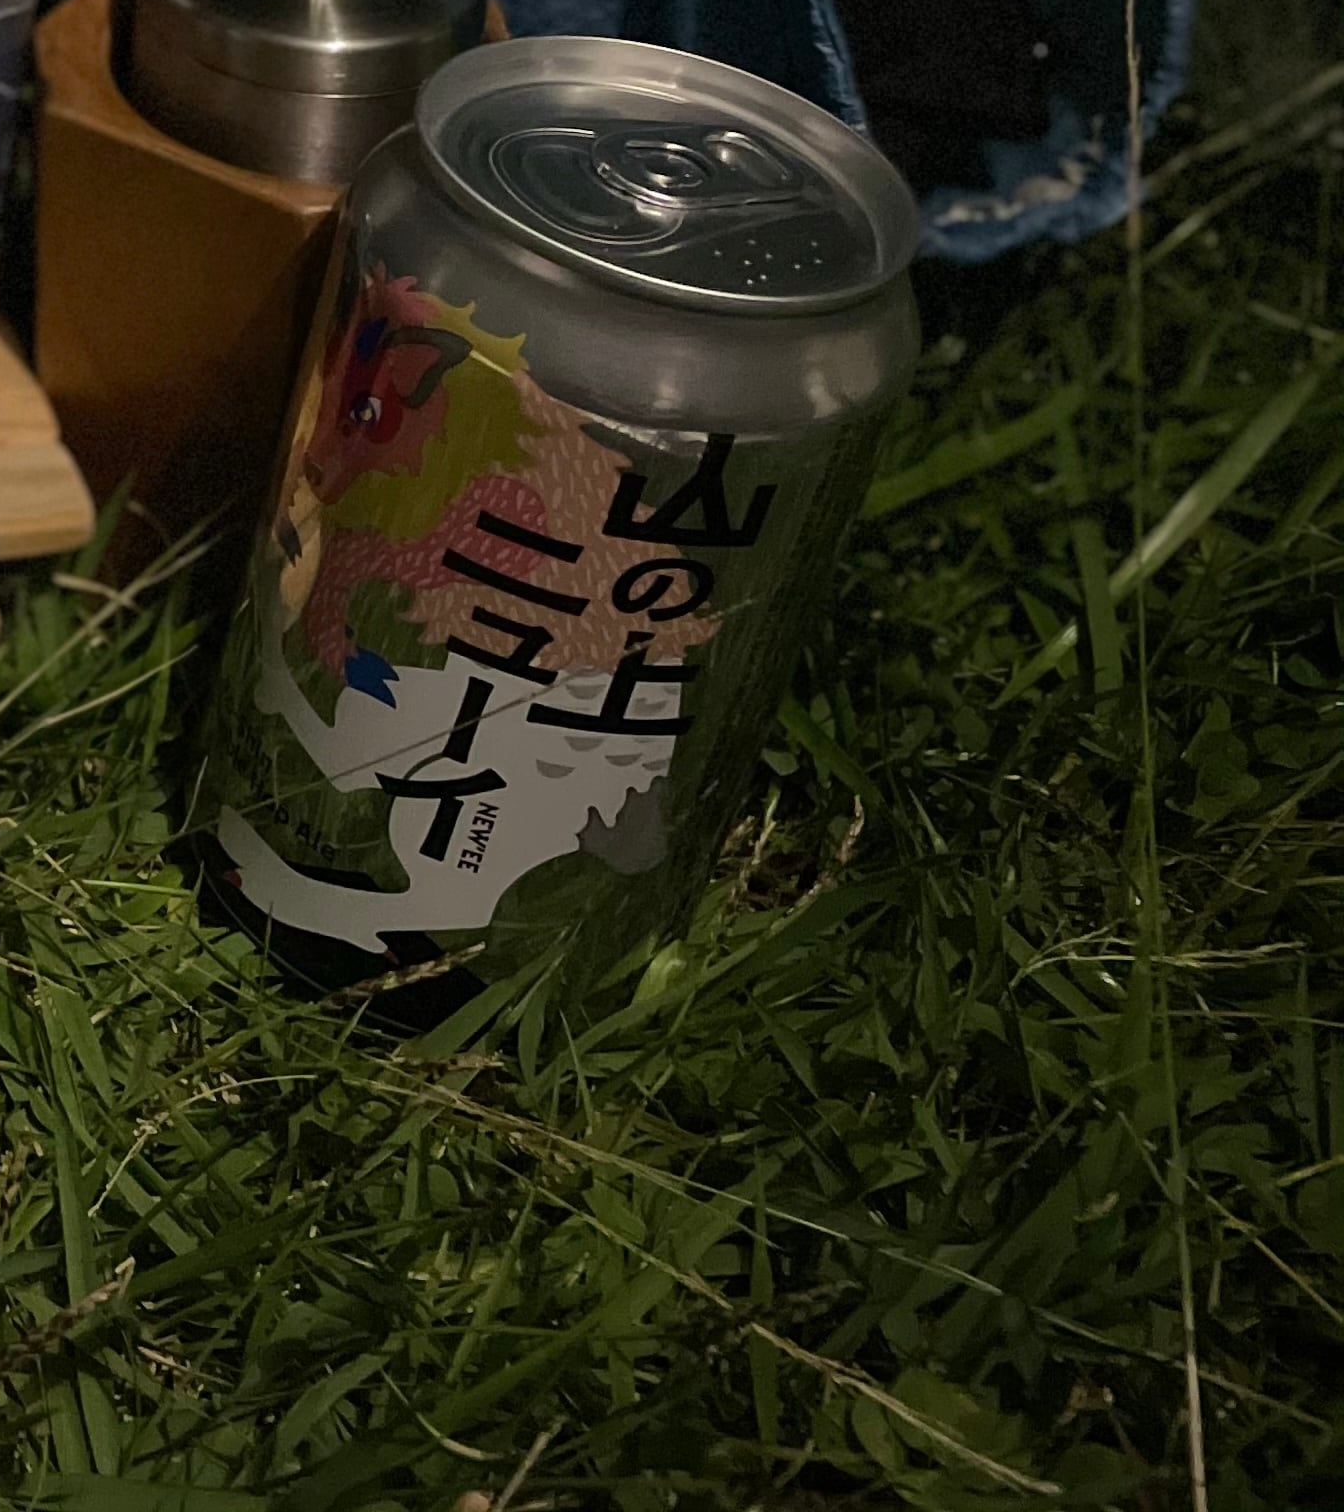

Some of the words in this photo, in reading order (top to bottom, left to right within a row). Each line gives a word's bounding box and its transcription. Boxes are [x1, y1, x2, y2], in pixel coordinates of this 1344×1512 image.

[526, 432, 779, 736] 山の上
[294, 821, 341, 863] Ale
[456, 801, 500, 874] NEW'EE
